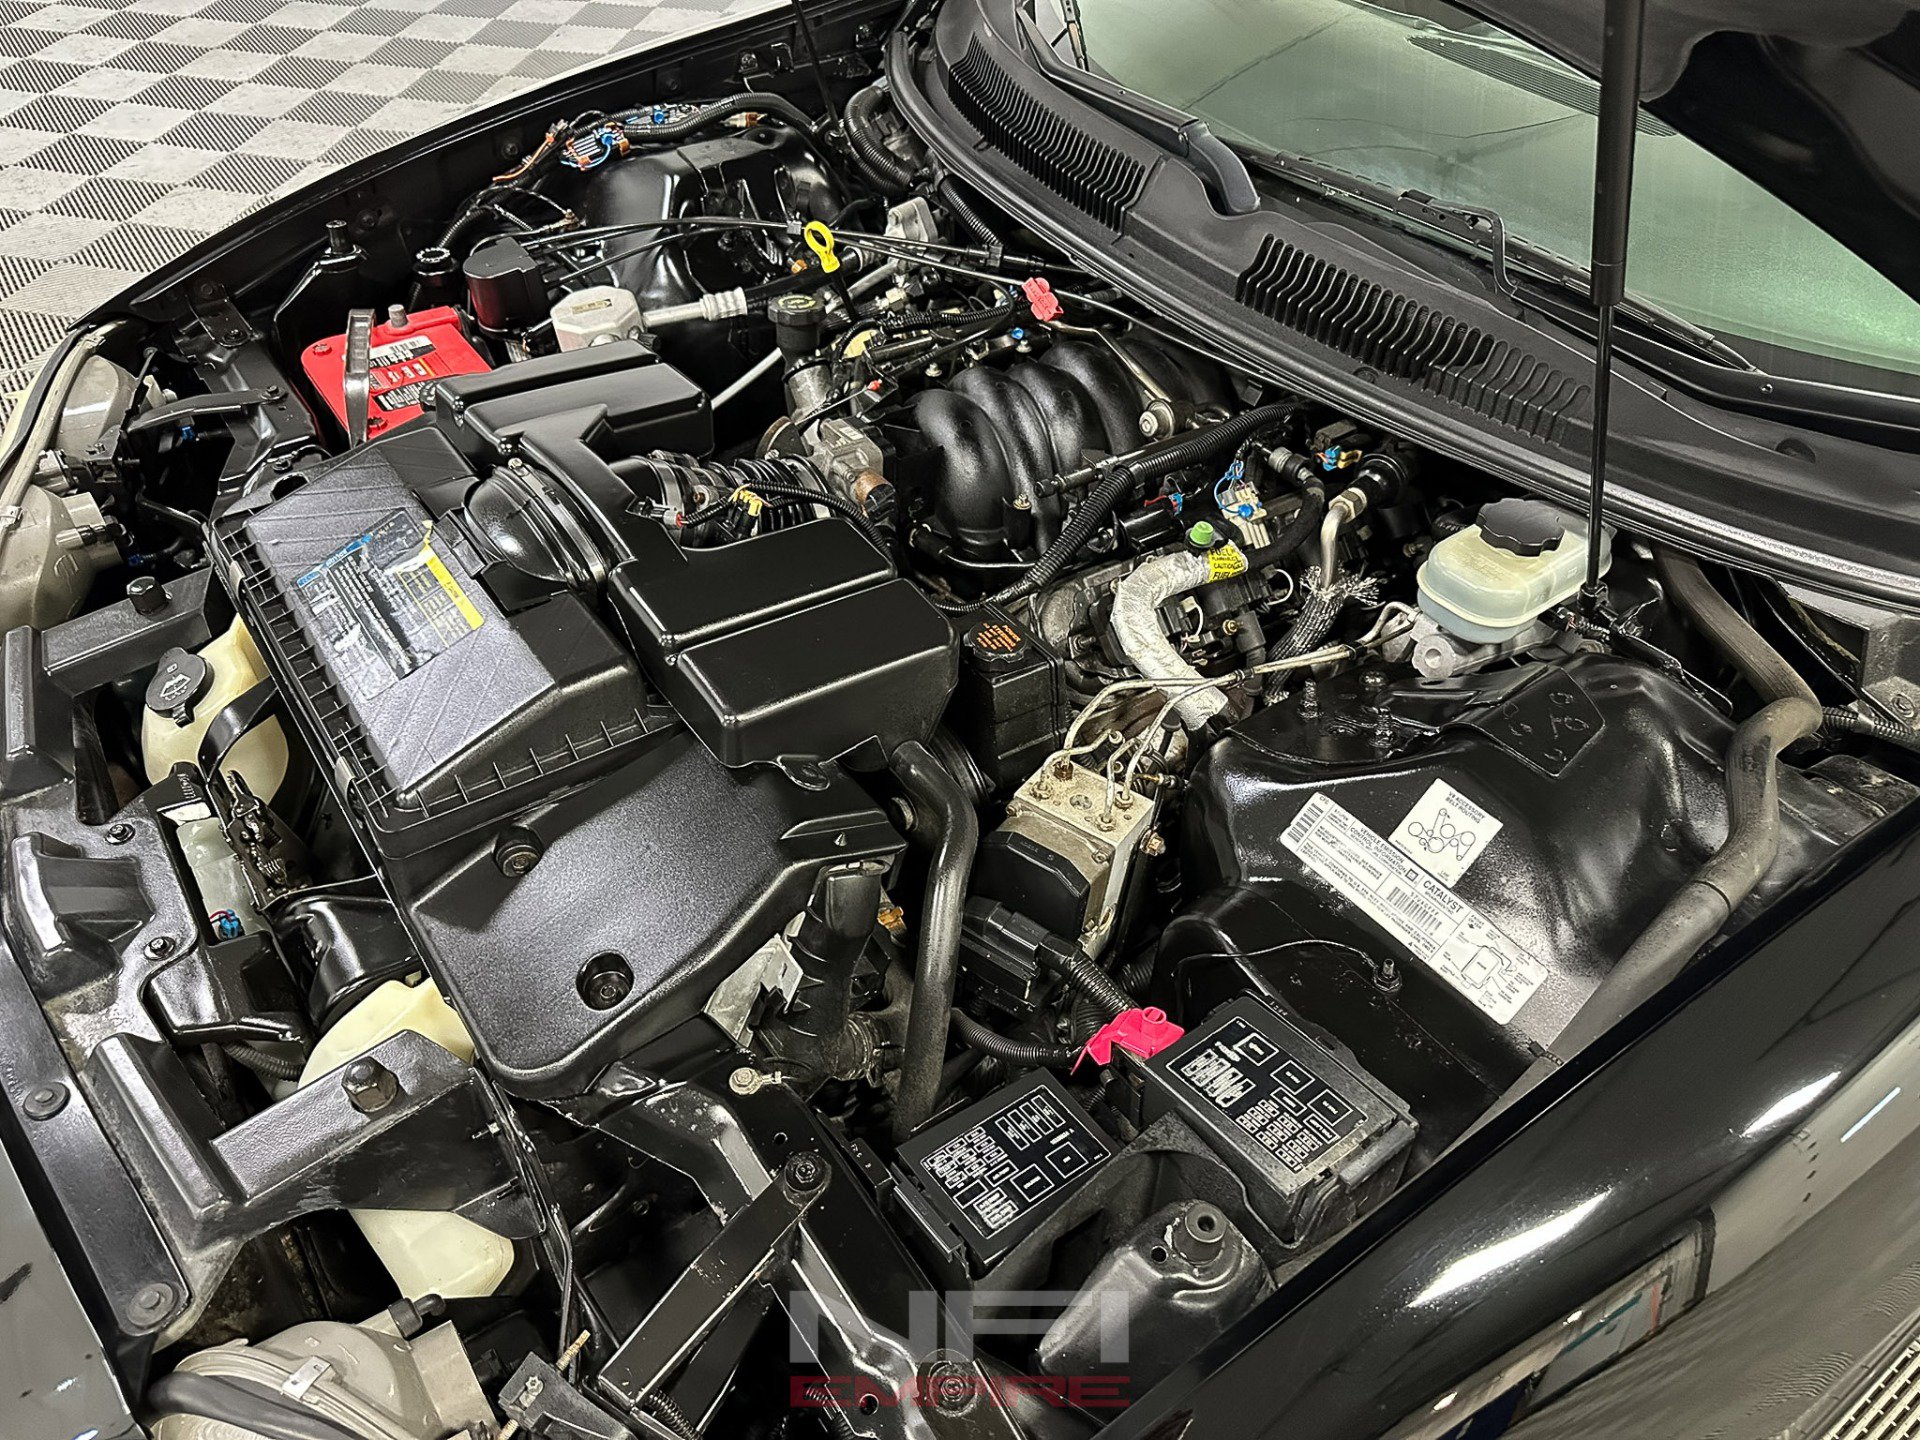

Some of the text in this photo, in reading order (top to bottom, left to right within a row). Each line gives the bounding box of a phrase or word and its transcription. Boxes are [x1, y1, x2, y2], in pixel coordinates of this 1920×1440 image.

[991, 623, 1016, 647] STEERING
[1001, 623, 1021, 642] POWER
[1444, 795, 1481, 824] BELT ROUTING
[1454, 796, 1485, 820] ACCESSORY
[1348, 826, 1374, 847] CONTROL
[1372, 844, 1407, 873] INFORMATION
[1359, 826, 1382, 845] VEHICLE
[1379, 842, 1405, 864] EMISSION
[1421, 878, 1464, 914] CATALYST
